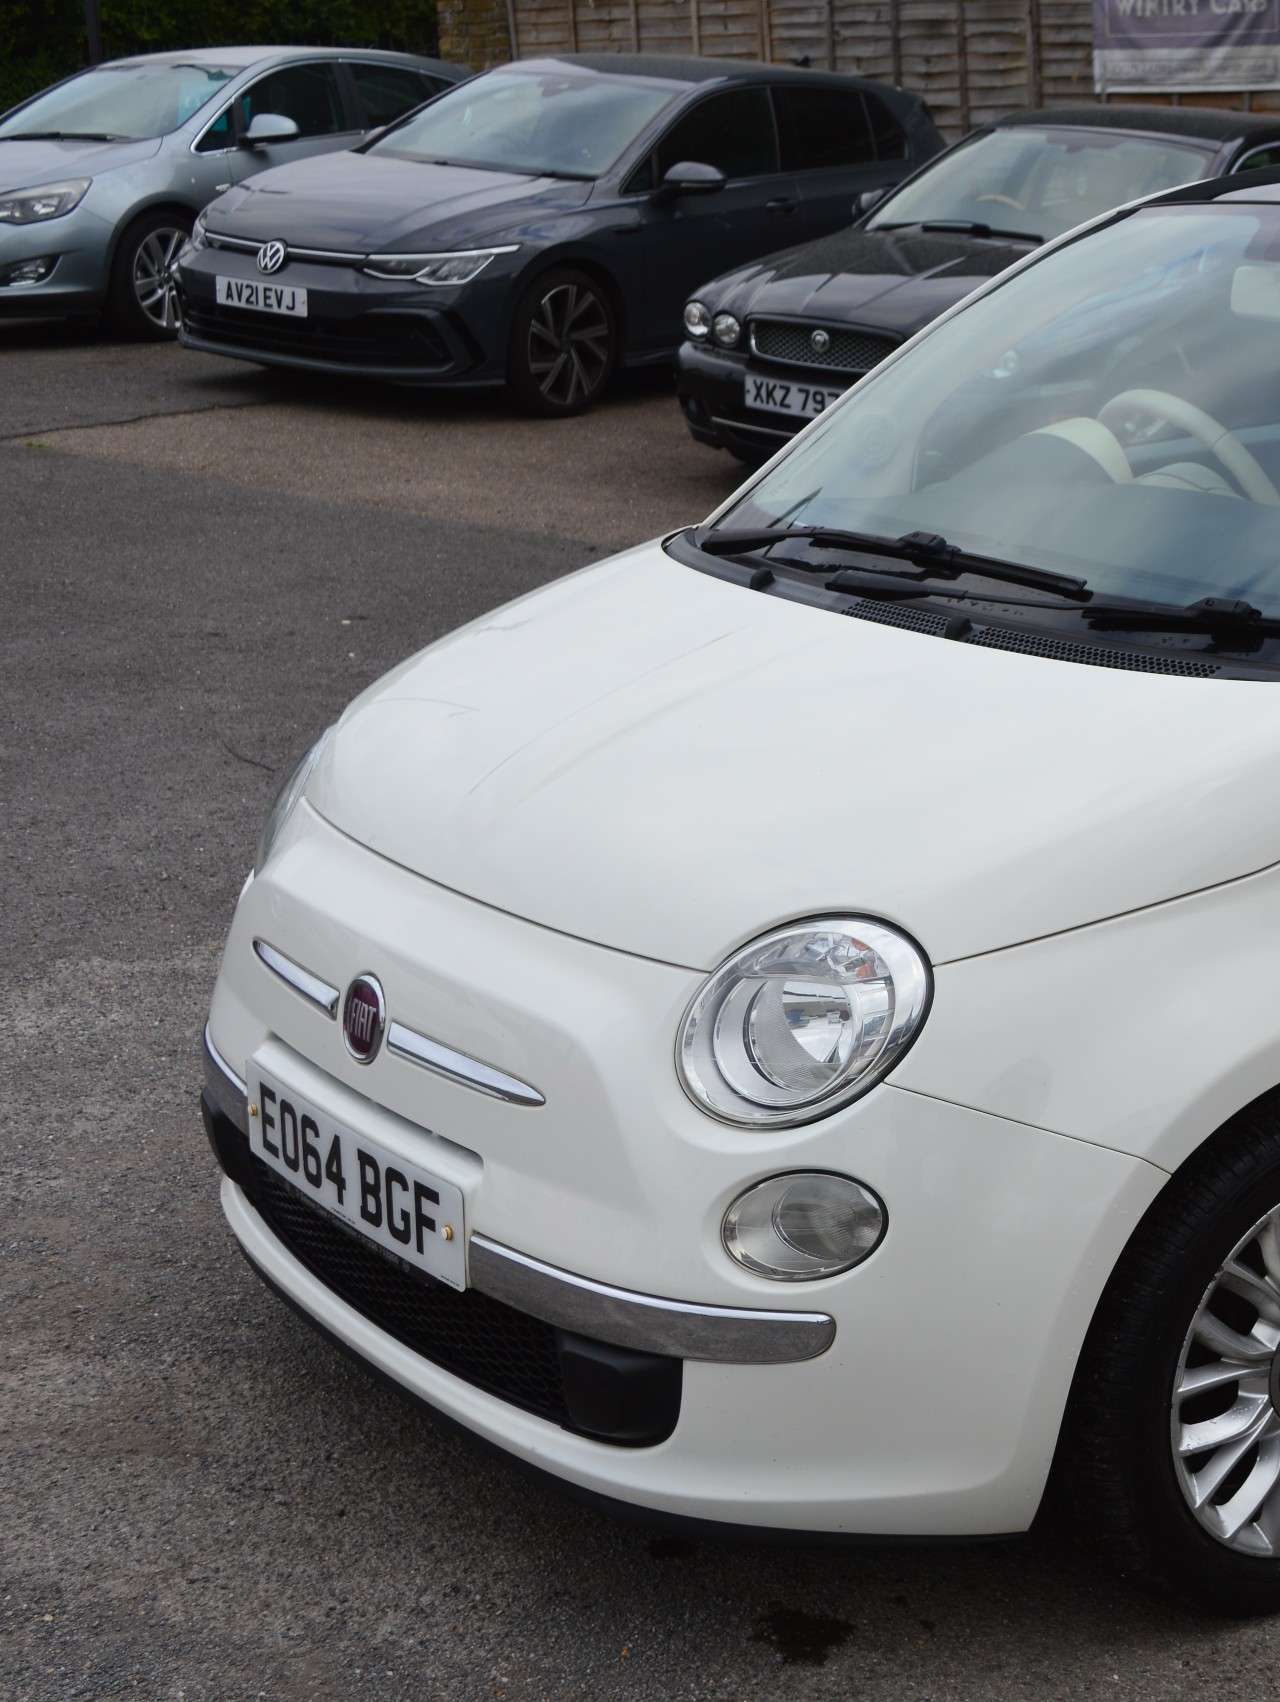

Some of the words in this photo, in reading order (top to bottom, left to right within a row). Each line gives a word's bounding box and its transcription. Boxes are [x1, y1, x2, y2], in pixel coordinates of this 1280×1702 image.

[225, 280, 259, 306] AV21
[263, 286, 296, 311] EVJ
[753, 380, 792, 409] XKZ
[350, 998, 377, 1042] FIAT
[356, 1148, 440, 1255] BGF
